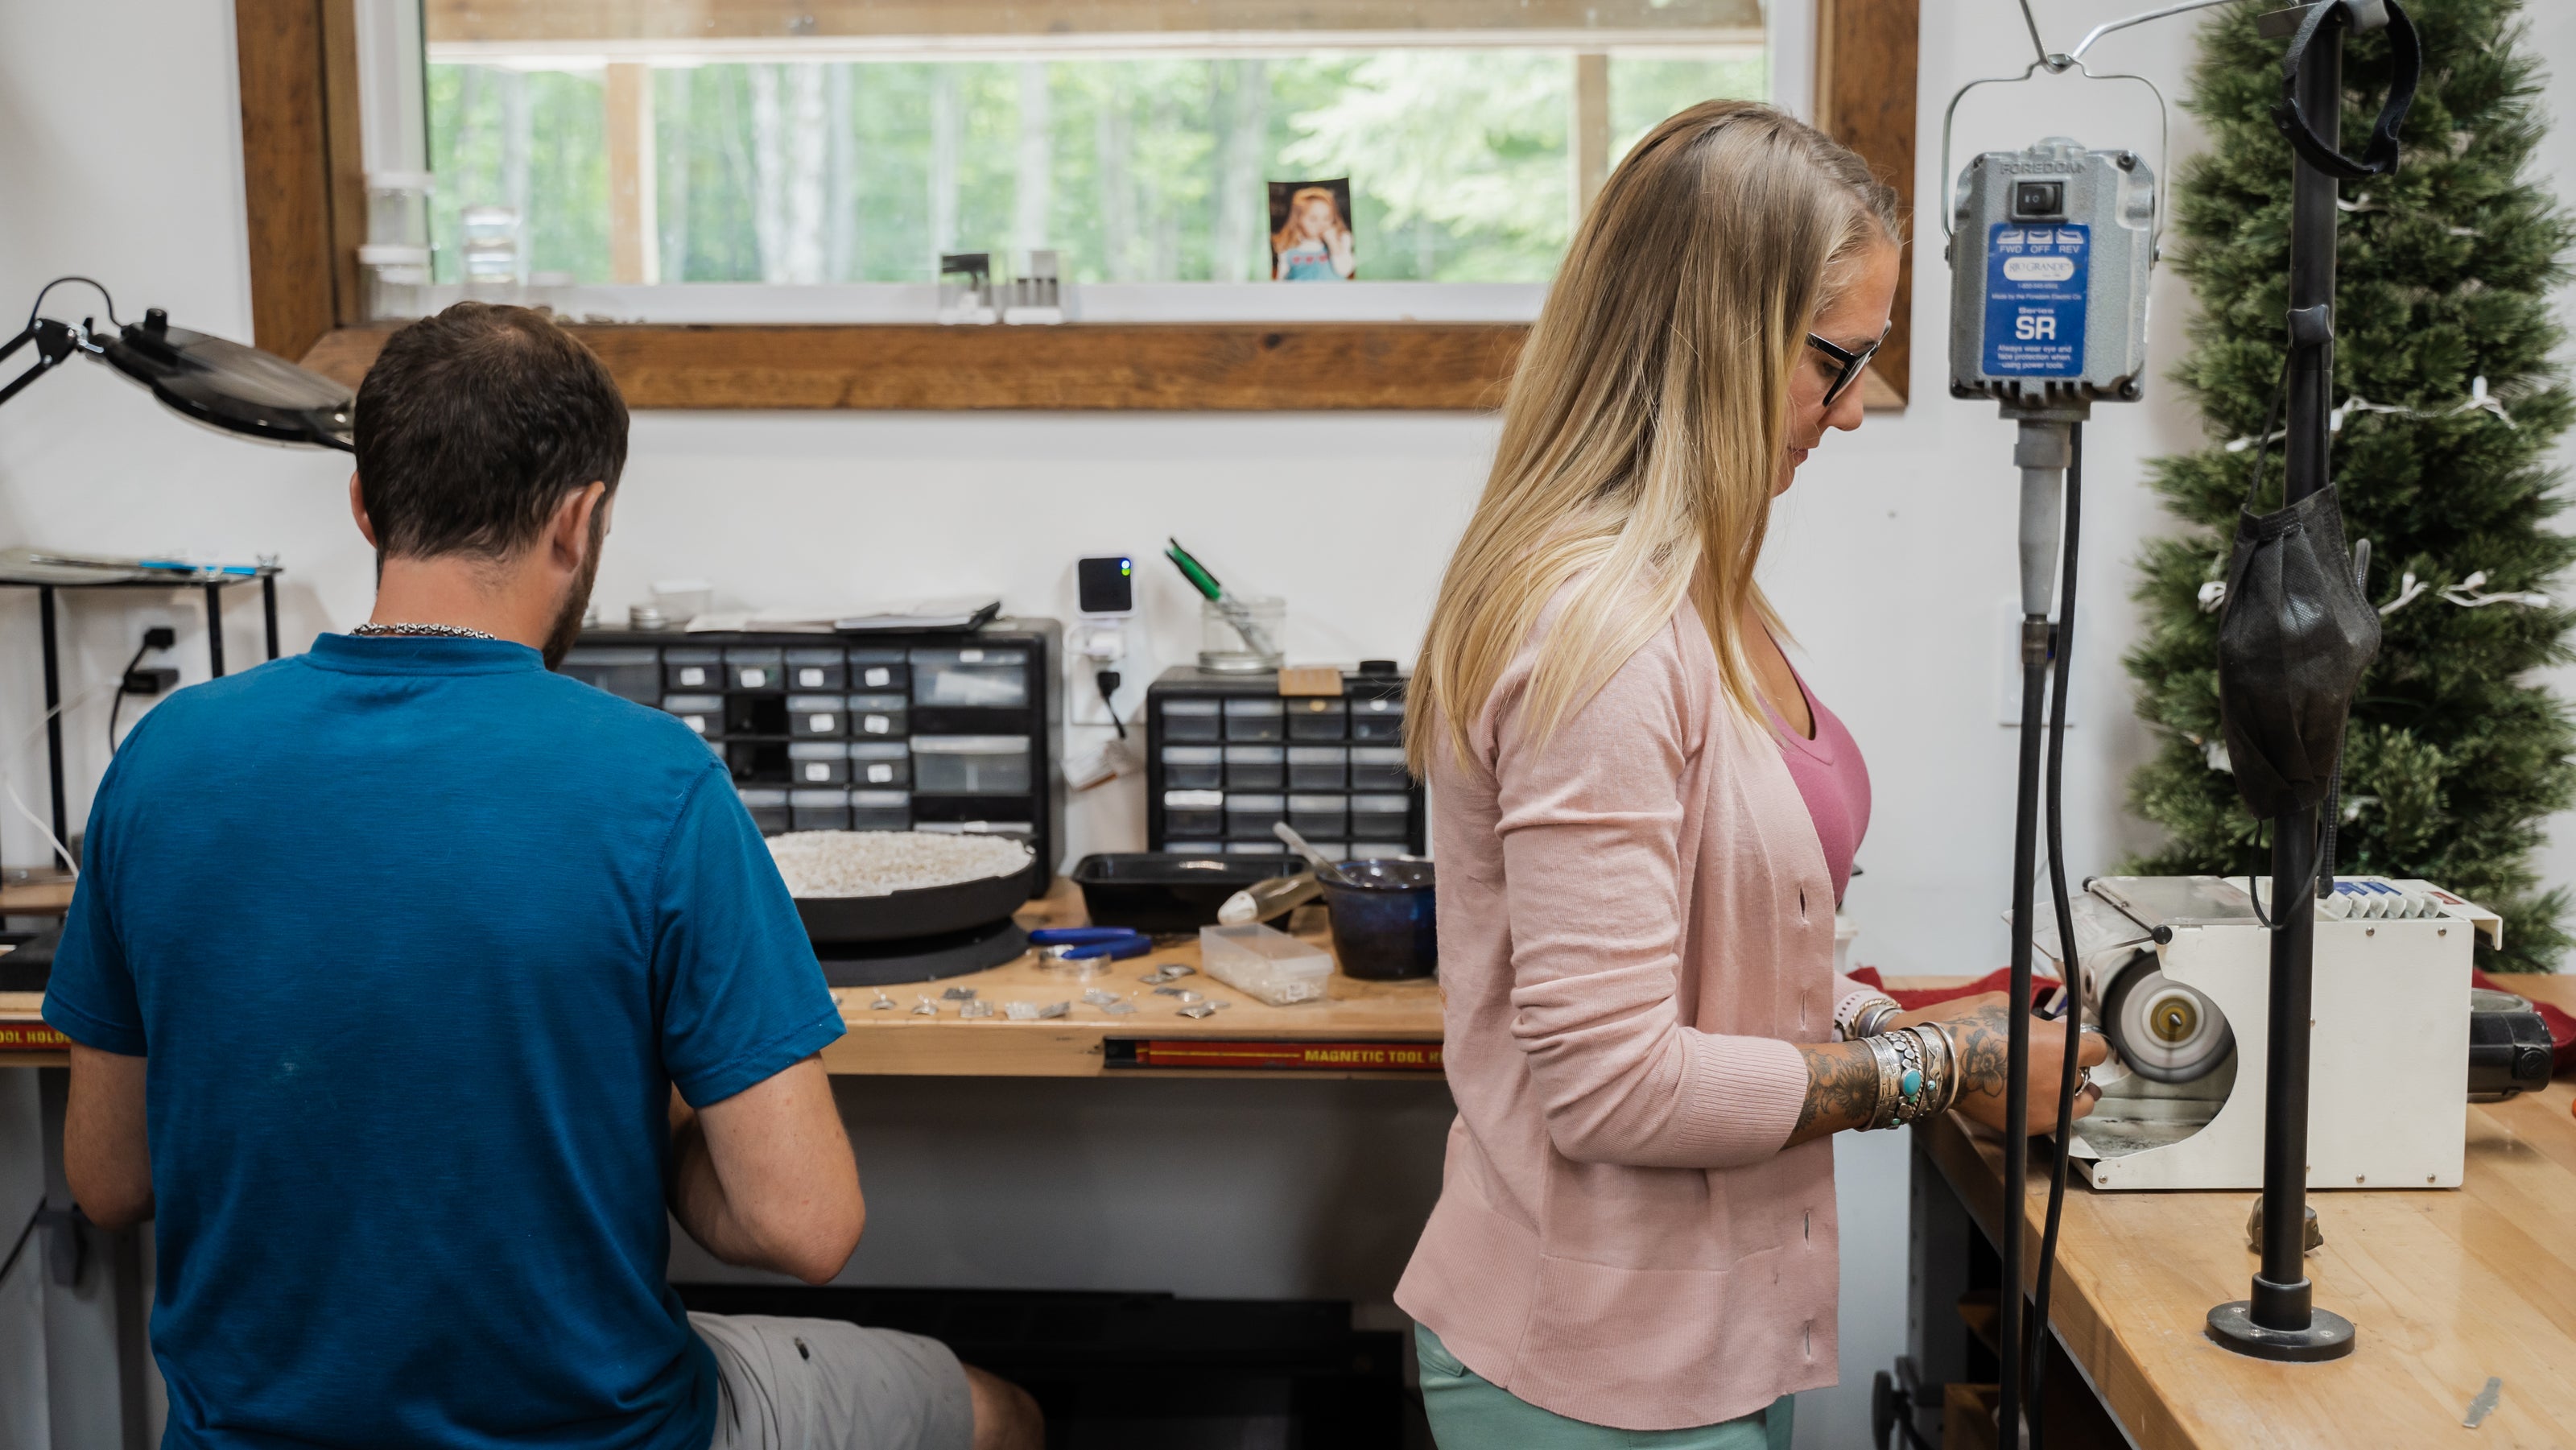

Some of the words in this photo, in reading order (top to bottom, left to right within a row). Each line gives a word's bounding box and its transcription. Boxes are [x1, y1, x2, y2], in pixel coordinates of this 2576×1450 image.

[2000, 162, 2087, 175] FOREDOM
[2000, 245, 2022, 254] FWD
[2029, 245, 2050, 254] OFF
[2058, 245, 2080, 254] REV
[2026, 262, 2066, 272] GRANDE
[2015, 316, 2055, 340] SR
[1997, 345, 2022, 353] Always
[2014, 353, 2050, 361] protection
[1305, 1050, 1384, 1063] MAGNETIC
[1389, 1051, 1425, 1064] TOOL
